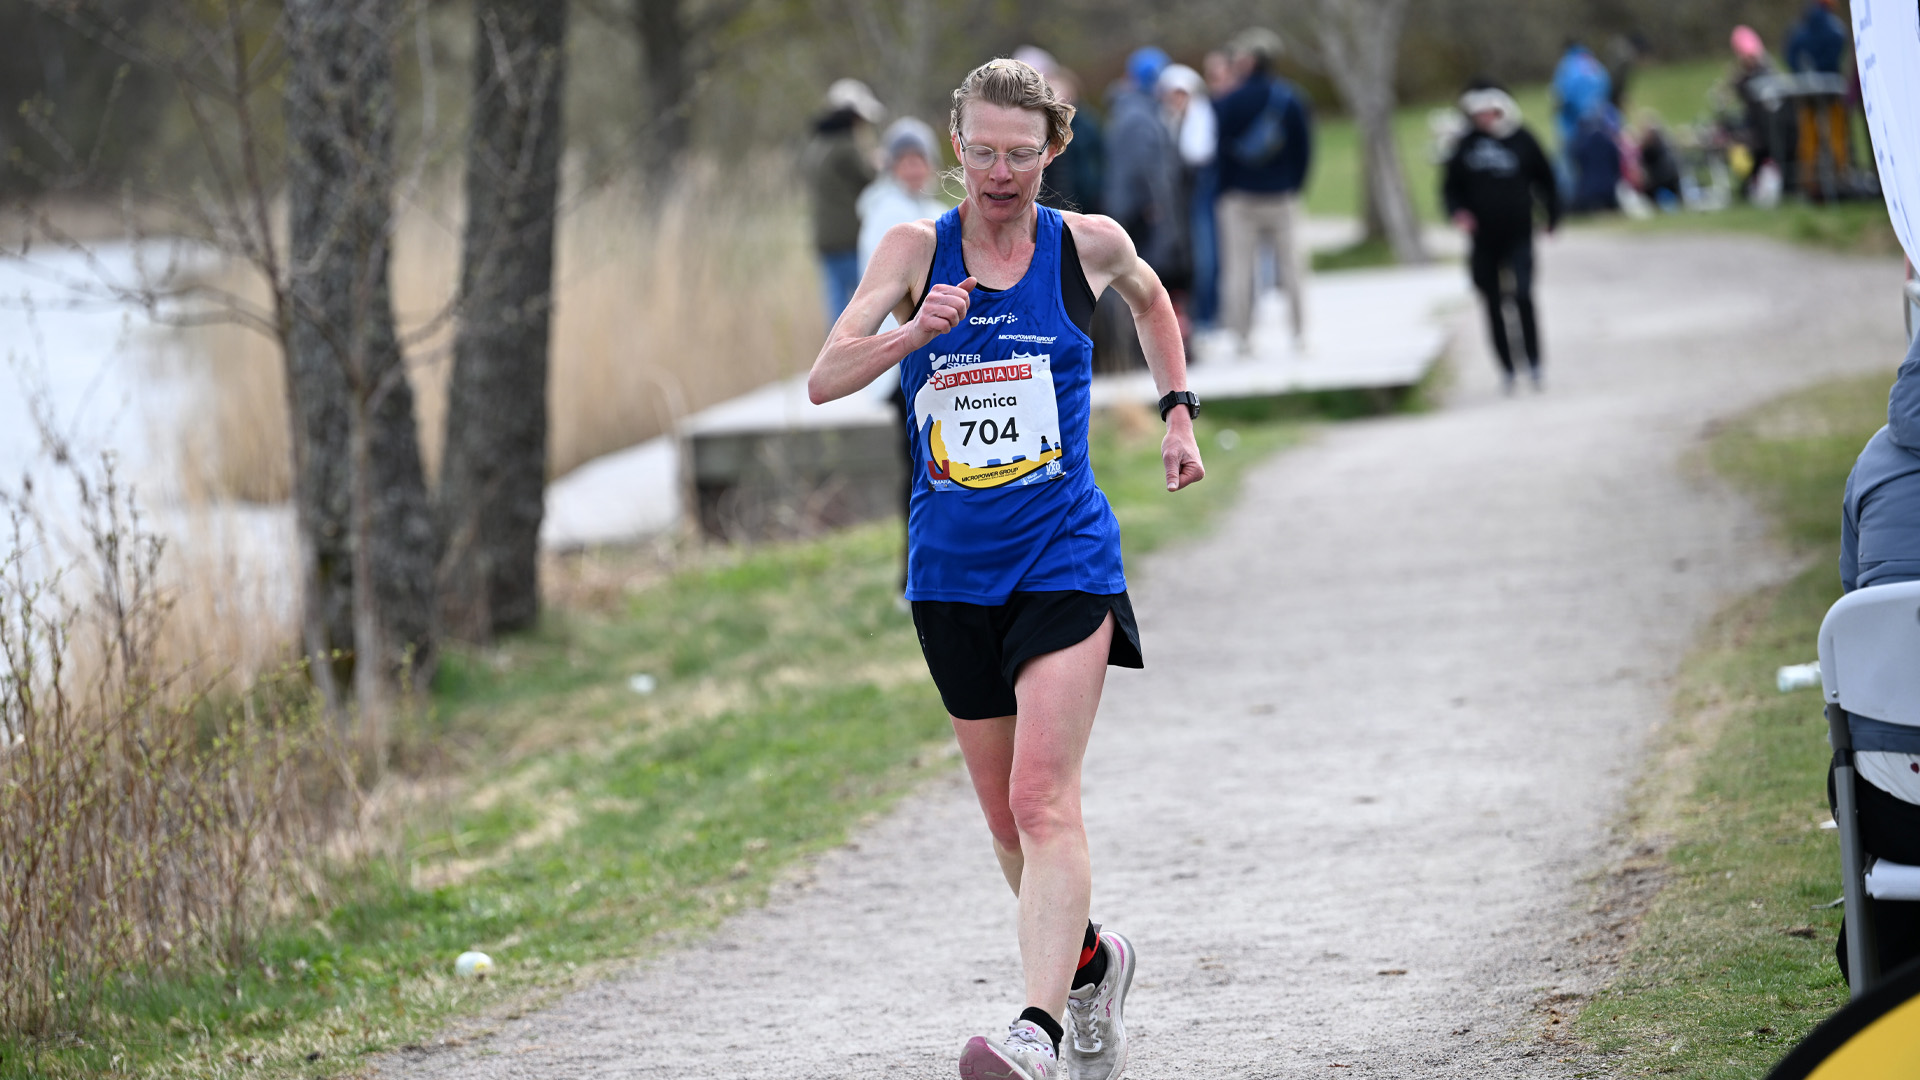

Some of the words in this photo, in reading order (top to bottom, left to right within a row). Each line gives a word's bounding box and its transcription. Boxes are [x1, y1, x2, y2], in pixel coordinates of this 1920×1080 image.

[969, 315, 1007, 325] CRAFT
[947, 354, 981, 363] INTER
[945, 365, 1031, 386] BAUHAUS
[954, 393, 1017, 411] Monica
[959, 417, 1019, 447] 704
[961, 471, 998, 482] MICROPOWER
[999, 467, 1019, 475] GROUP
